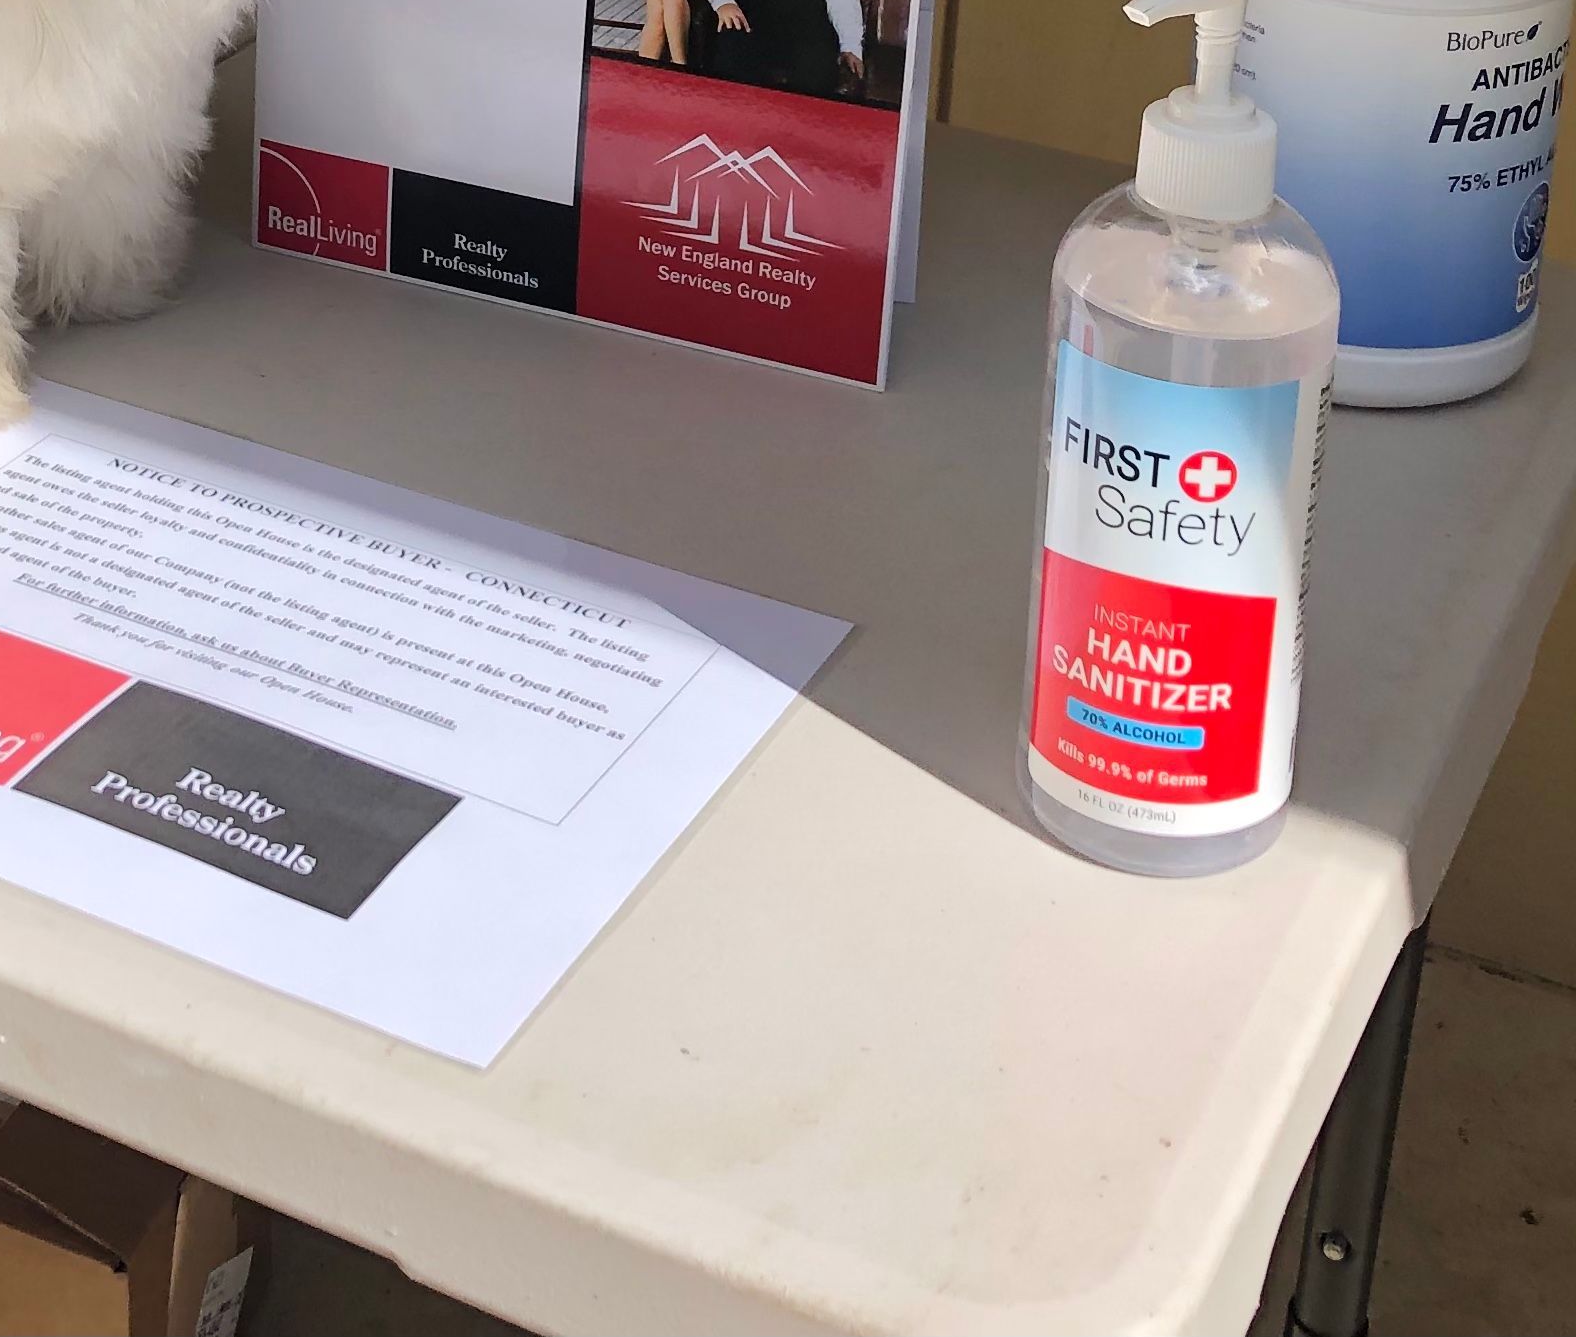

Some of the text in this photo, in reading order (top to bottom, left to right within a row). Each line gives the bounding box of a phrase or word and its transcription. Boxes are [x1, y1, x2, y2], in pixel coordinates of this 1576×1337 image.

[1446, 29, 1526, 52] BioPure
[1428, 86, 1548, 144] Hand
[1448, 172, 1491, 193] 75%
[1496, 154, 1544, 187] ETHYL
[267, 205, 378, 257] RealLiving
[453, 232, 509, 262] Realty
[421, 247, 540, 289] Professionals
[637, 235, 817, 291] New England Realty
[656, 264, 793, 310] Services Group
[1062, 415, 1172, 490] FIRST
[11, 491, 40, 504] sale
[40, 500, 61, 509] of
[56, 504, 80, 517] the
[1094, 483, 1258, 558] Safety
[9, 551, 50, 568] agent
[50, 565, 72, 574] of
[67, 569, 92, 583] the
[24, 454, 650, 663] The listing agent holding this Open House is the designated agent of the seller. The listing
[106, 457, 187, 488] NOTICE
[189, 482, 218, 498] TO
[219, 493, 365, 545] PROSPECTIVE
[365, 539, 442, 570] BUYER
[465, 571, 631, 628] CONNECTICUT
[2, 469, 42, 485] agent
[41, 481, 76, 496] owes
[76, 491, 100, 504] the
[99, 500, 139, 515] seller
[139, 511, 188, 532] loyalty
[187, 528, 219, 542] and
[218, 538, 320, 575] confidentiality
[321, 569, 338, 581] in
[340, 577, 419, 607] connection
[422, 602, 456, 619] with
[458, 614, 484, 628] the
[573, 653, 663, 688] negotiating
[32, 518, 68, 533] sales
[67, 529, 108, 547] agent
[108, 542, 130, 552] of
[125, 548, 153, 560] our
[154, 556, 224, 585] Company
[223, 579, 257, 595] (not
[256, 590, 282, 604] the
[282, 598, 330, 621] listing
[380, 630, 396, 641] is
[394, 637, 456, 661] present
[455, 657, 475, 668] at
[475, 663, 507, 678] this
[508, 673, 552, 694] Open
[8, 530, 50, 547] agent
[48, 541, 63, 552] is
[62, 548, 90, 560] not
[88, 556, 100, 565] a
[100, 560, 179, 589] designated
[177, 586, 220, 604] agent
[220, 600, 242, 610] of
[238, 605, 264, 618] the
[263, 614, 307, 632] seller
[306, 629, 340, 643] and
[339, 639, 374, 655] may
[374, 651, 450, 681] represent
[449, 677, 472, 689] an
[473, 683, 555, 716] interested
[555, 710, 606, 733] buyer
[605, 729, 626, 741] as
[13, 572, 46, 589] For
[42, 582, 99, 607] further
[187, 633, 219, 647] ask
[215, 642, 240, 655] us
[236, 649, 287, 670] about
[333, 679, 457, 730] Representation.
[1093, 603, 1192, 643] INSTANT
[1051, 643, 1233, 713] SANITIZER
[1086, 626, 1193, 678] HAND
[1080, 707, 1186, 745] 70% ALCOHOL
[1057, 736, 1208, 787] Kills 99.9% of Germs
[89, 768, 318, 878] Professionals
[175, 766, 286, 825] Realty
